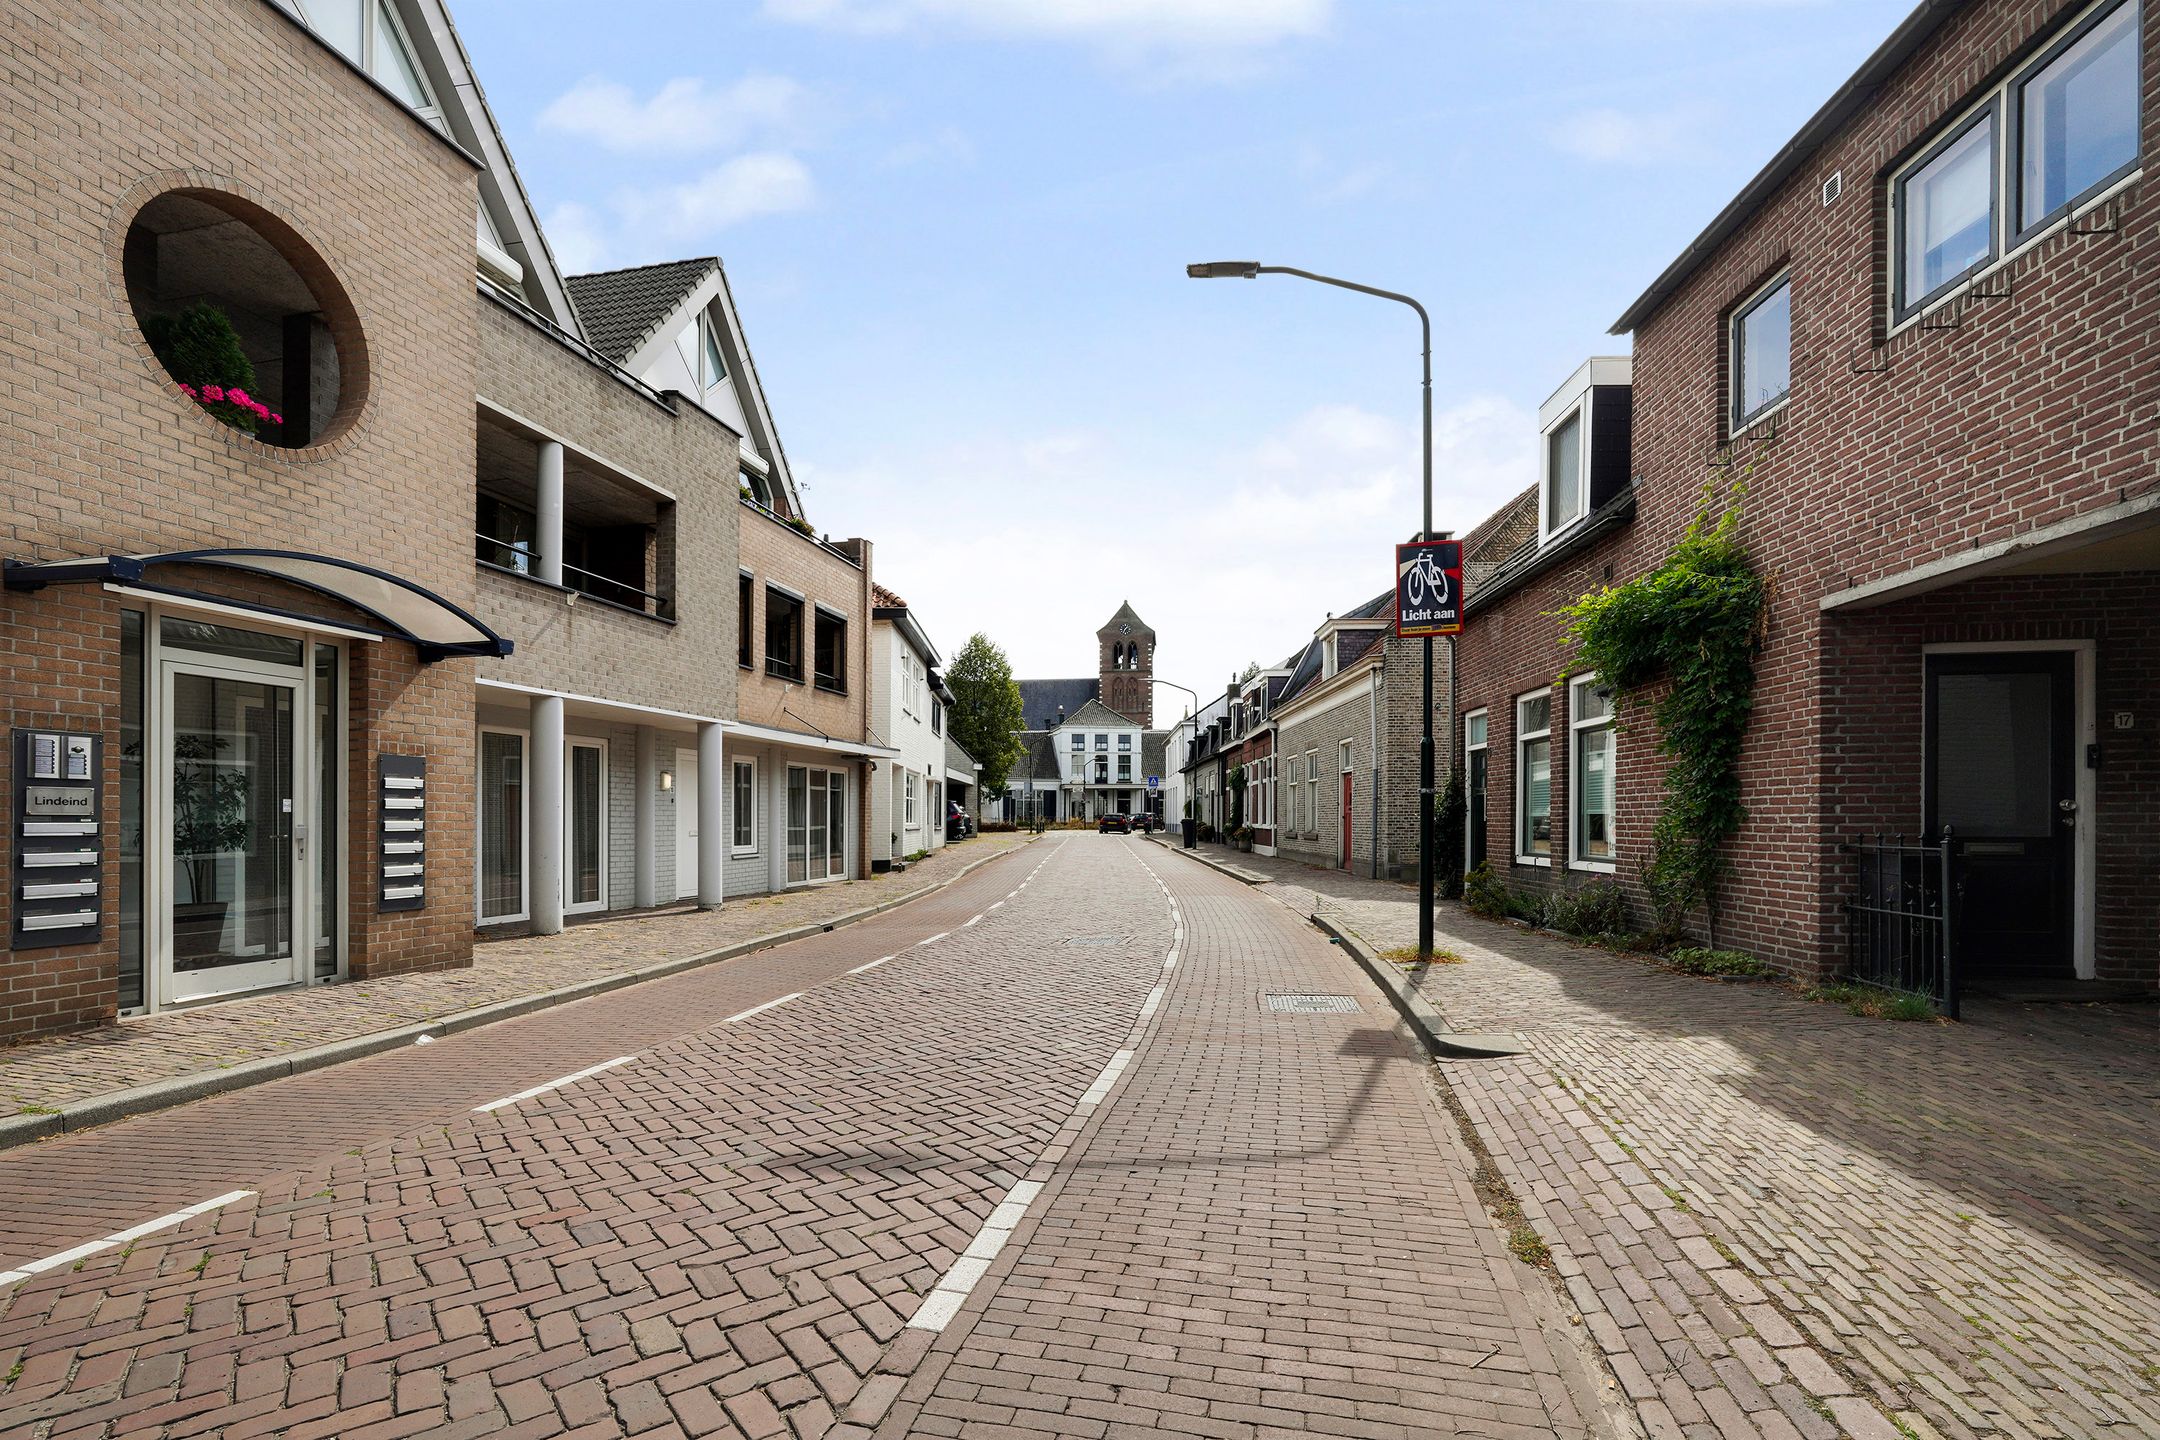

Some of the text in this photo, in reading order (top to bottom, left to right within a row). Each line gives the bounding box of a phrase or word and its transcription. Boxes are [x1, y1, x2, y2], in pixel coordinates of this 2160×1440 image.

[1402, 608, 1455, 622] Licht aan
[2117, 714, 2131, 726] 17
[34, 796, 88, 806] Lindeind
